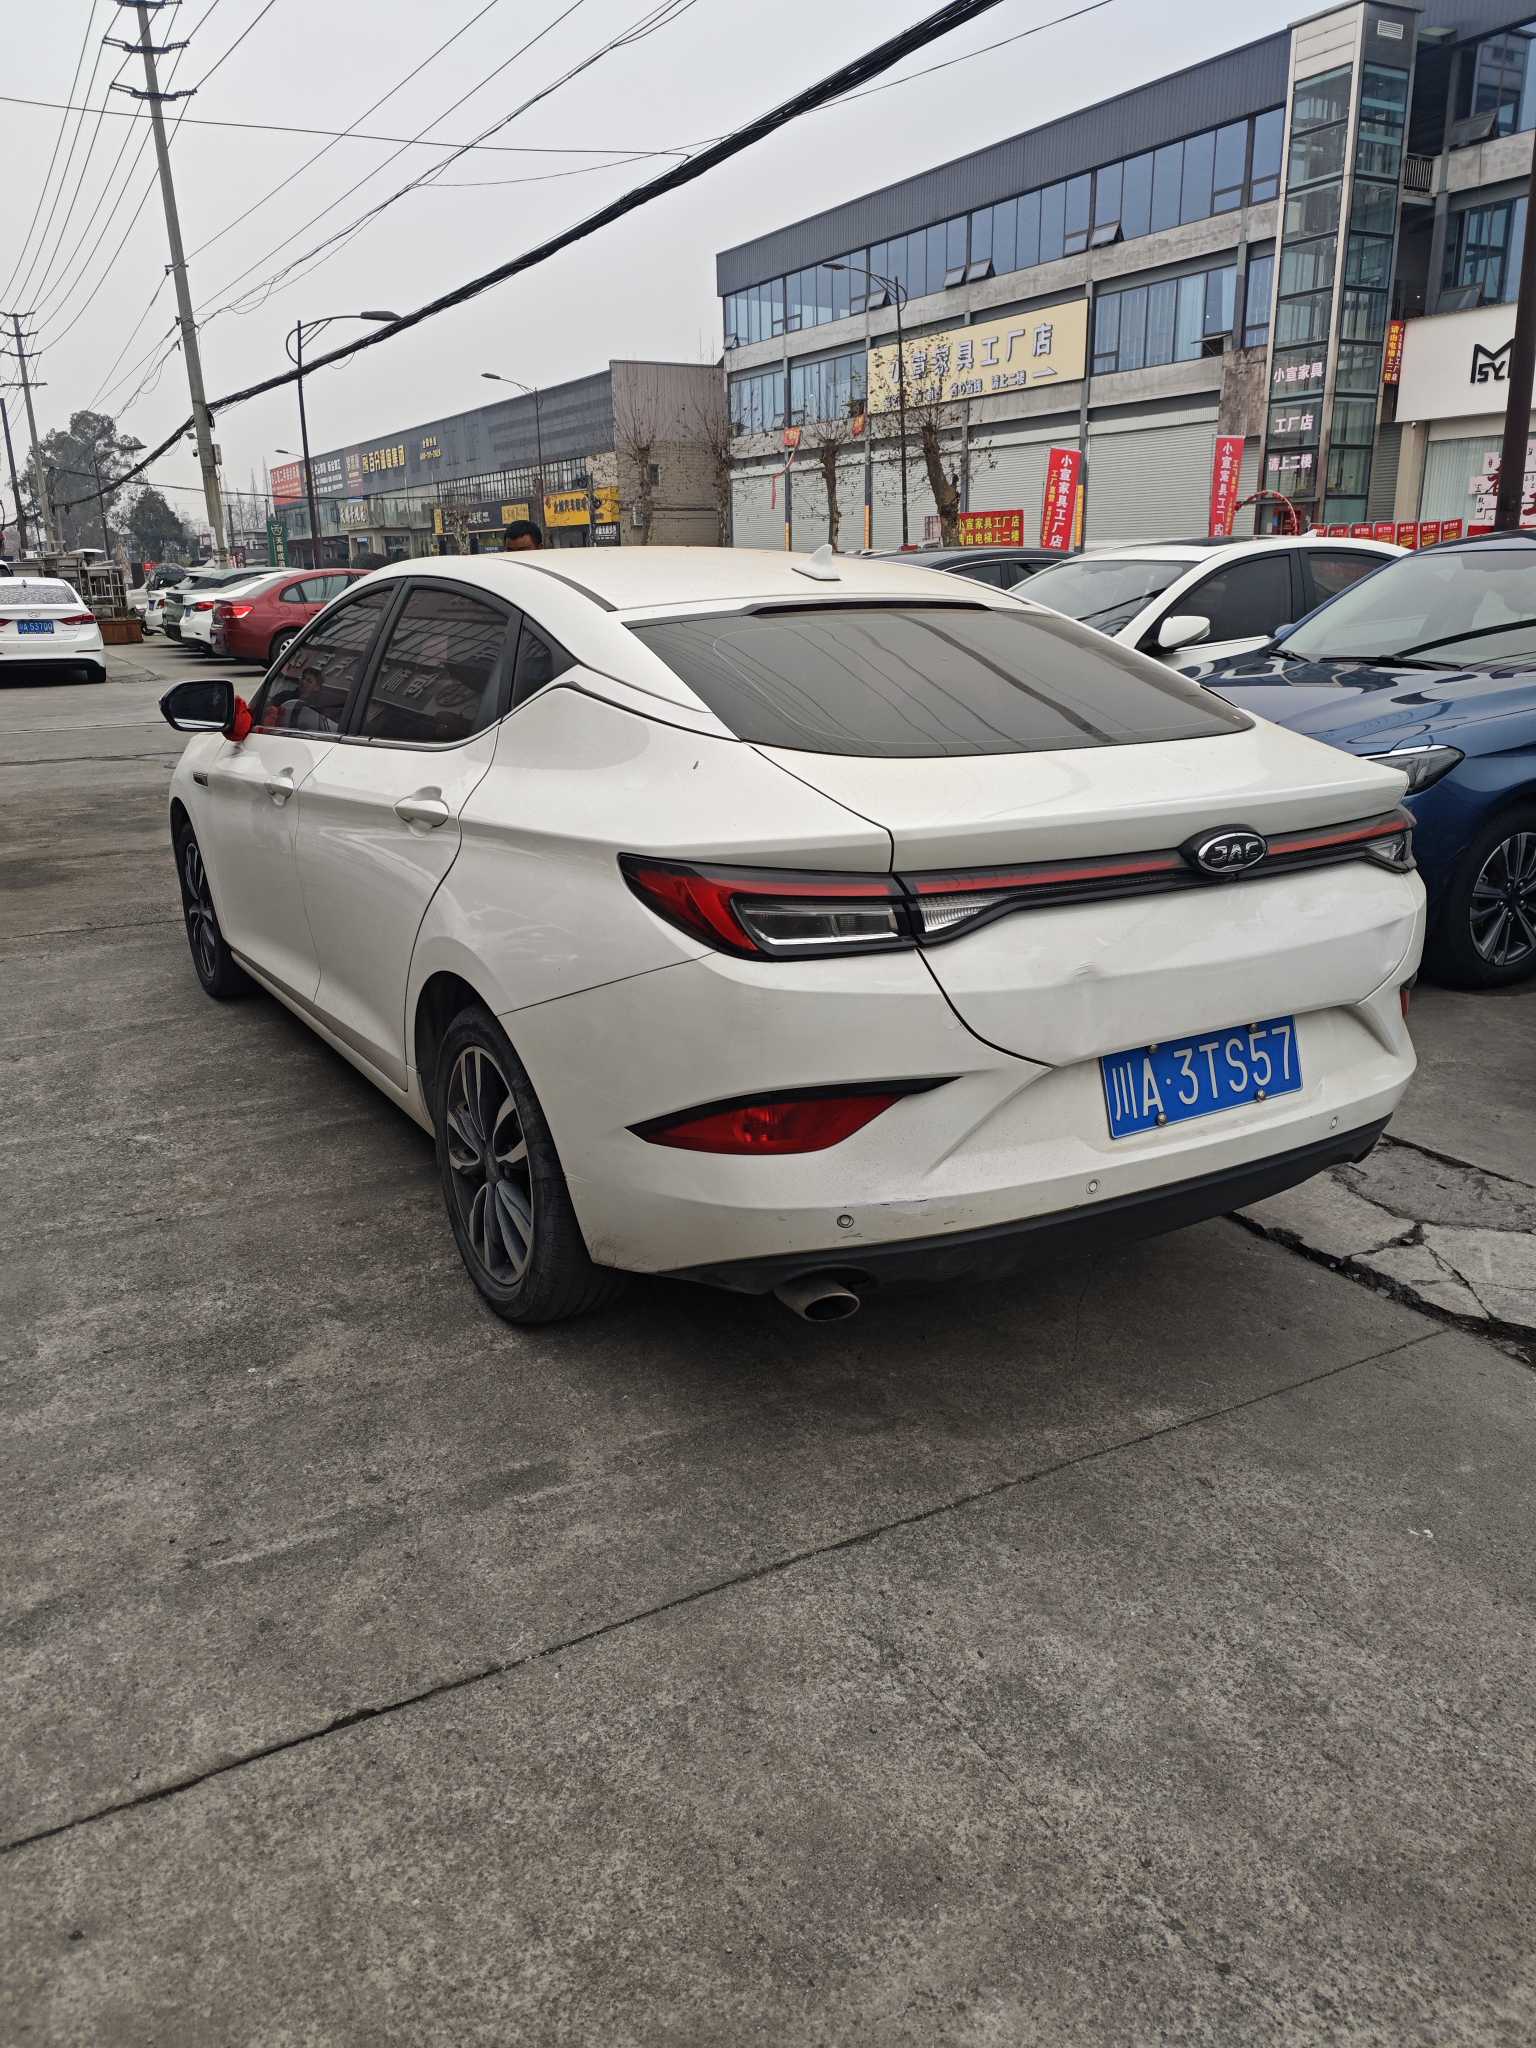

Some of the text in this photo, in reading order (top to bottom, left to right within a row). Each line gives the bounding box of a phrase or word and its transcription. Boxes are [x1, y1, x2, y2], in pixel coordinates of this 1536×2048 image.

[1274, 362, 1323, 383] 小宣家具
[1274, 414, 1314, 433] 工厂店
[1269, 454, 1313, 472] 请上二楼
[1049, 455, 1073, 547] 小宣家具工厂店
[1112, 1025, 1291, 1121] 川A·3TS57
